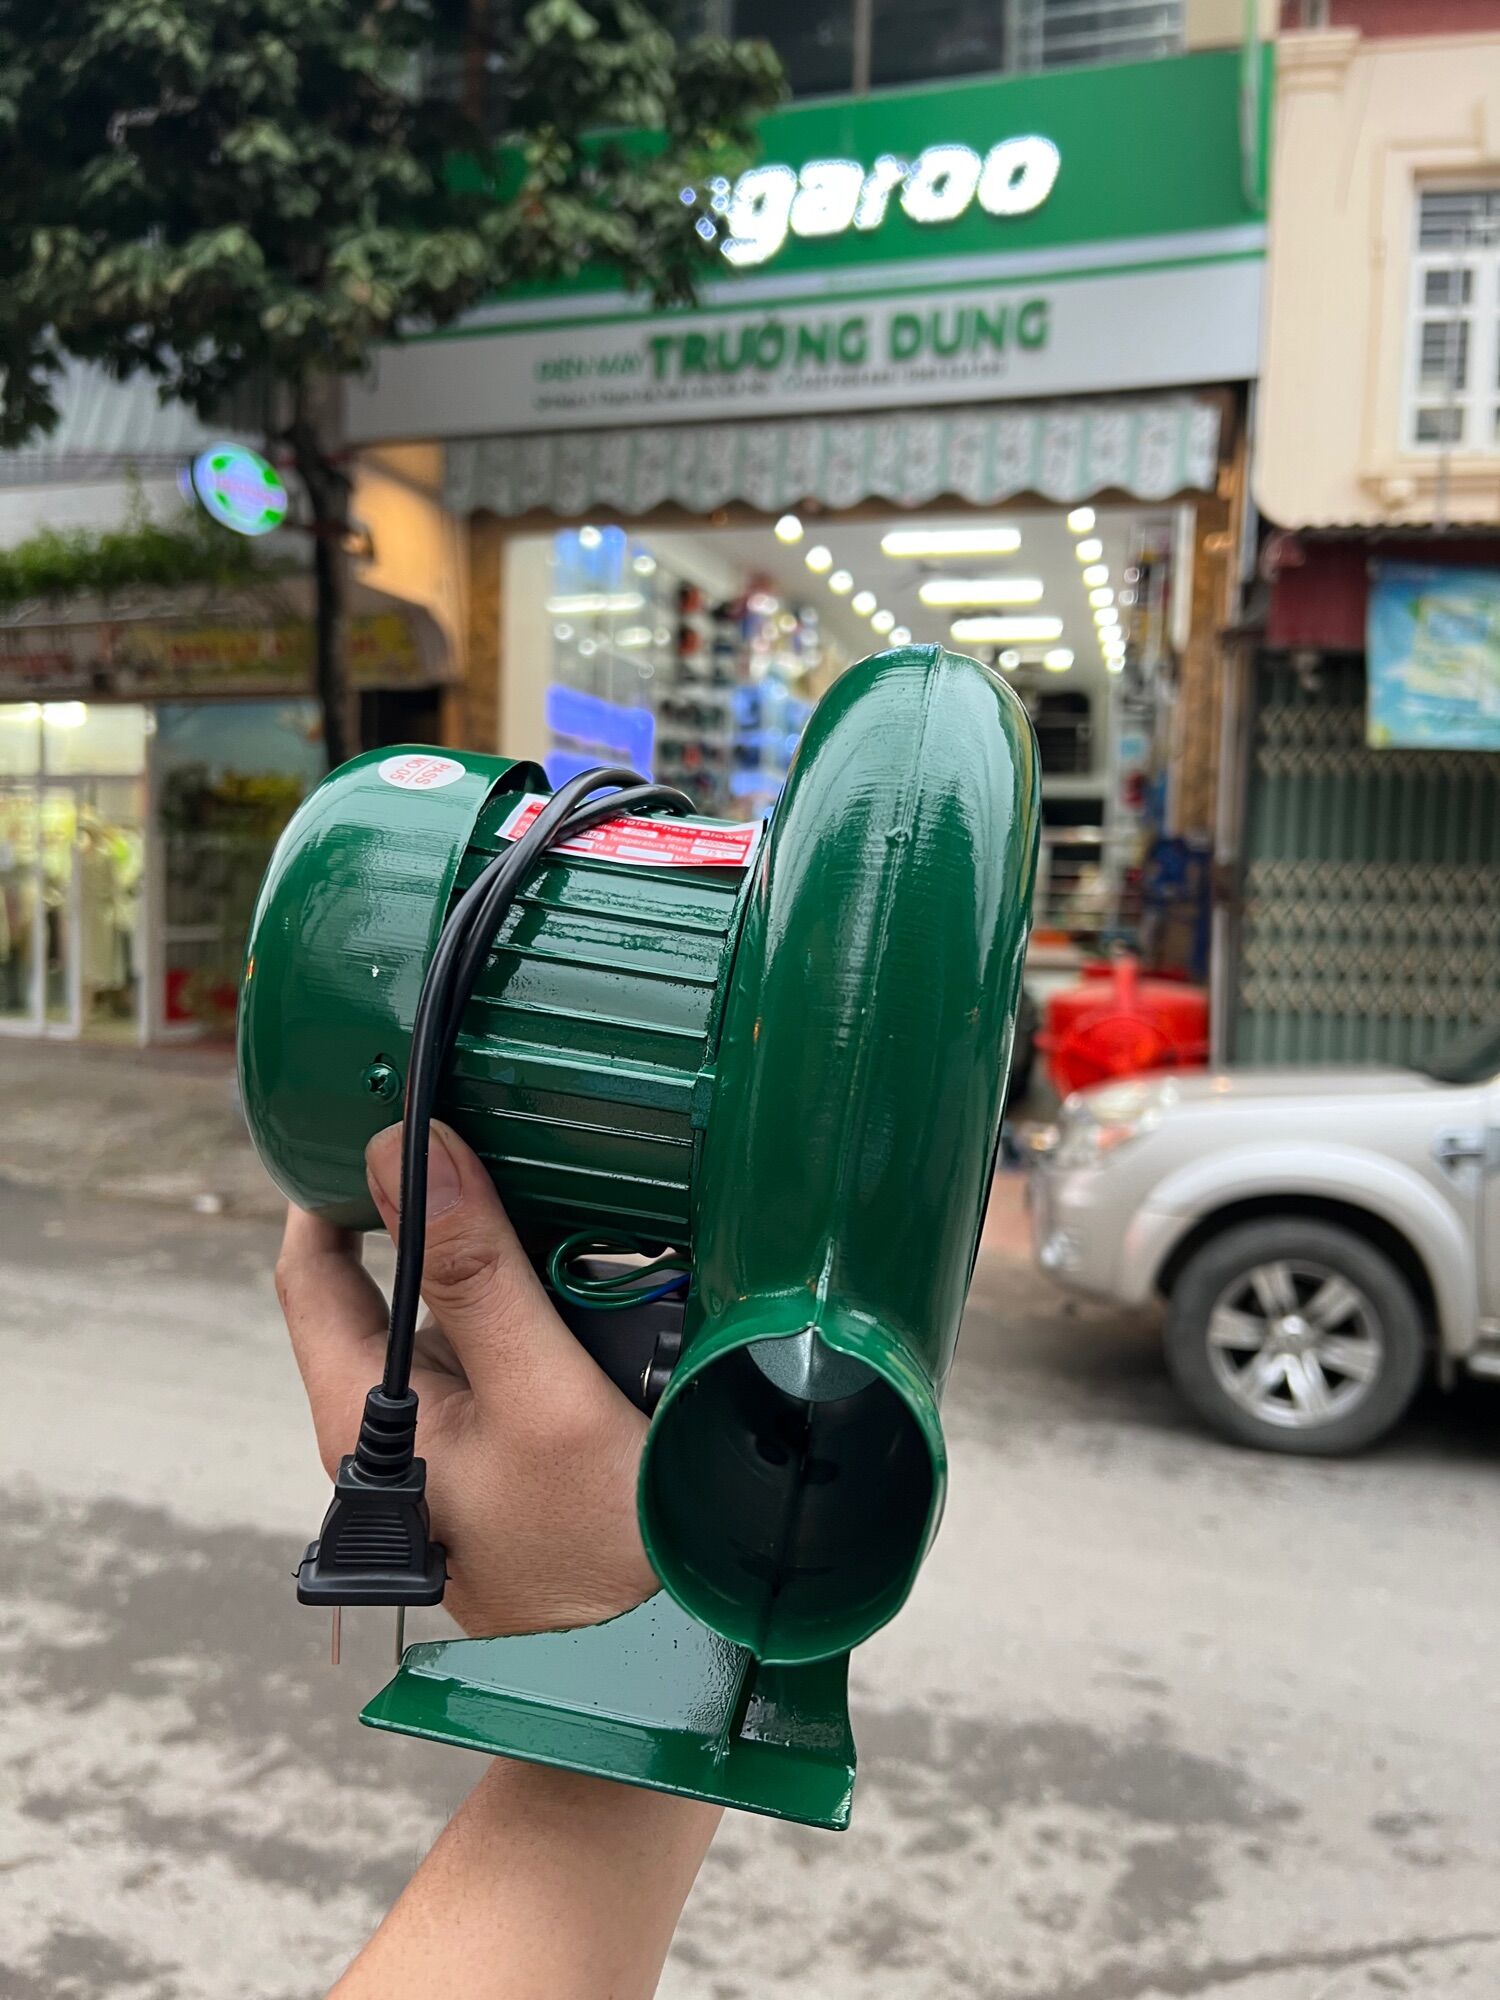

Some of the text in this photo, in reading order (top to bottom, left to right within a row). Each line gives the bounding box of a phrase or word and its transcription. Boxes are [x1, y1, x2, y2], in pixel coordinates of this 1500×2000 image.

[679, 133, 1061, 267] garoo
[888, 300, 1051, 362] DUNG
[415, 762, 452, 785] PASS
[614, 818, 751, 841] ingle Phase Blower
[594, 842, 615, 852] Year
